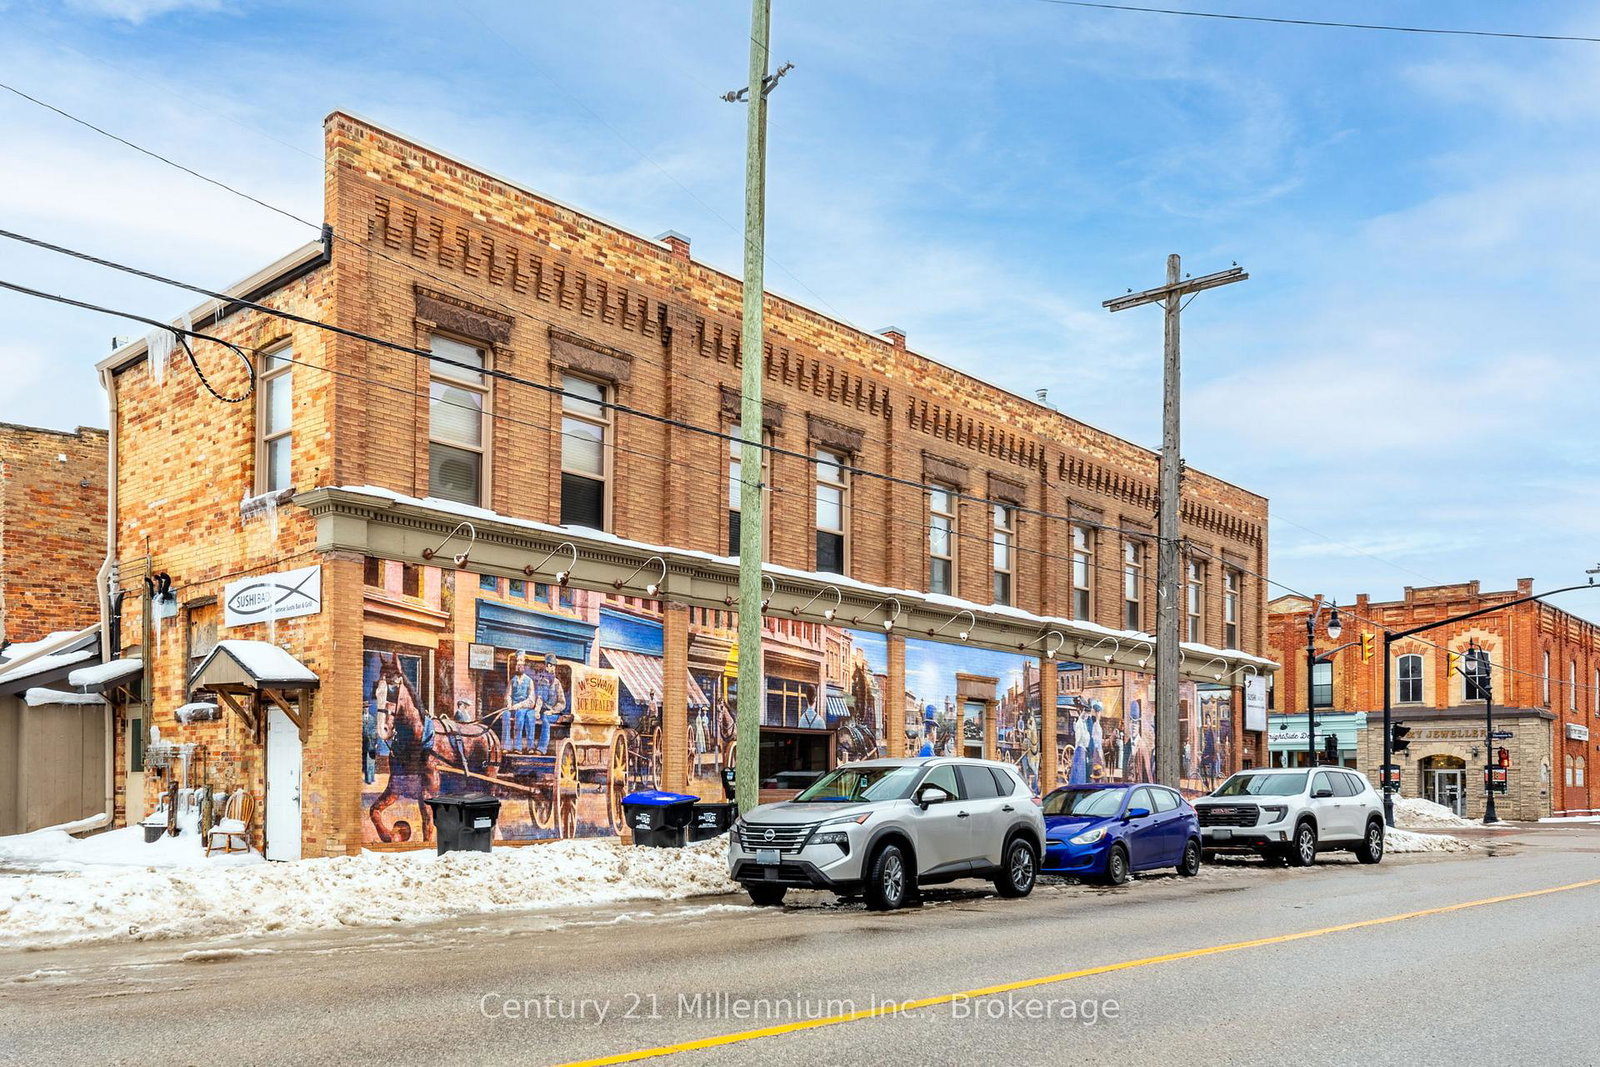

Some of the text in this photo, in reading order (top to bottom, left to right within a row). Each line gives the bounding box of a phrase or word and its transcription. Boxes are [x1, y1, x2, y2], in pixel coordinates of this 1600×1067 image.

[236, 594, 257, 608] SUSHI
[590, 677, 614, 695] SWAIN
[577, 697, 614, 712] ICE DEALER
[1425, 729, 1487, 739] JEWELLER
